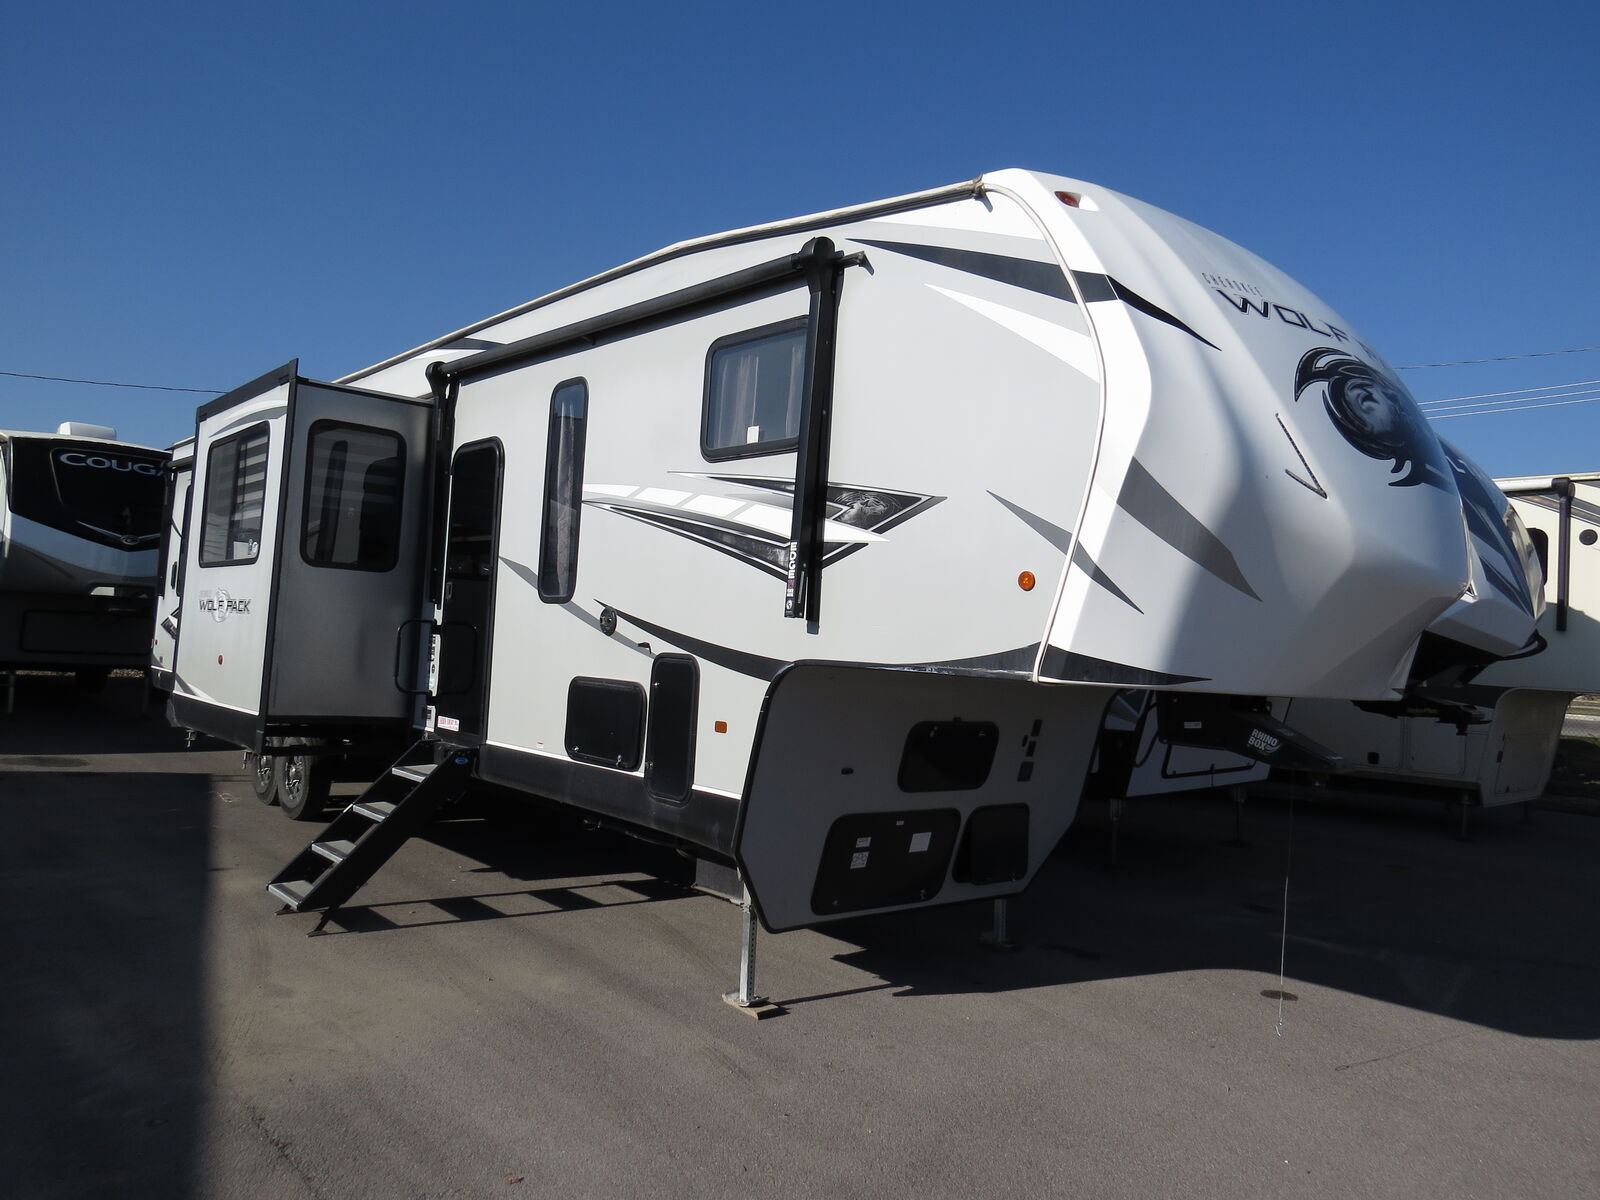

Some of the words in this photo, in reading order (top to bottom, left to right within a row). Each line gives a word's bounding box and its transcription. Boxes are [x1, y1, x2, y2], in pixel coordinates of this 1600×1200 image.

[1211, 287, 1349, 342] WOLF
[60, 453, 164, 476] COUG
[788, 541, 798, 579] EDGE
[199, 599, 225, 611] WOLF
[226, 599, 251, 614] PACK
[1248, 736, 1266, 751] BOX
[1251, 728, 1278, 746] RHINO
